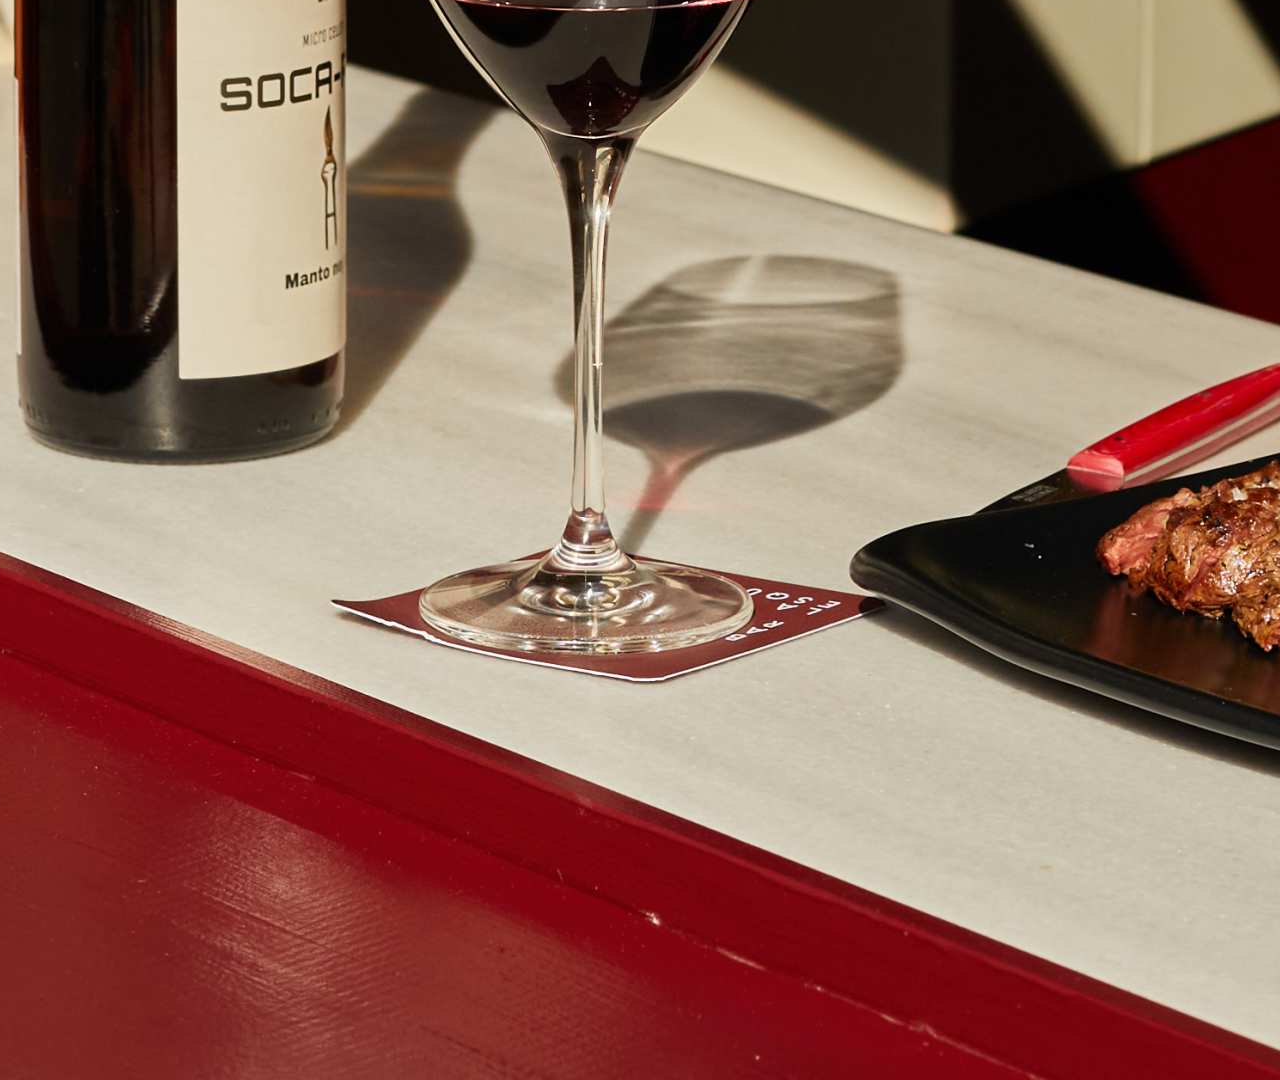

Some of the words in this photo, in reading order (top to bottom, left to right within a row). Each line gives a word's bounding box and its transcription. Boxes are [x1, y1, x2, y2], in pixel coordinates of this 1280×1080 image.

[220, 51, 345, 112] SOCA-
[285, 266, 330, 290] Manto
[777, 602, 823, 616] LA
[725, 620, 785, 642] BAR
